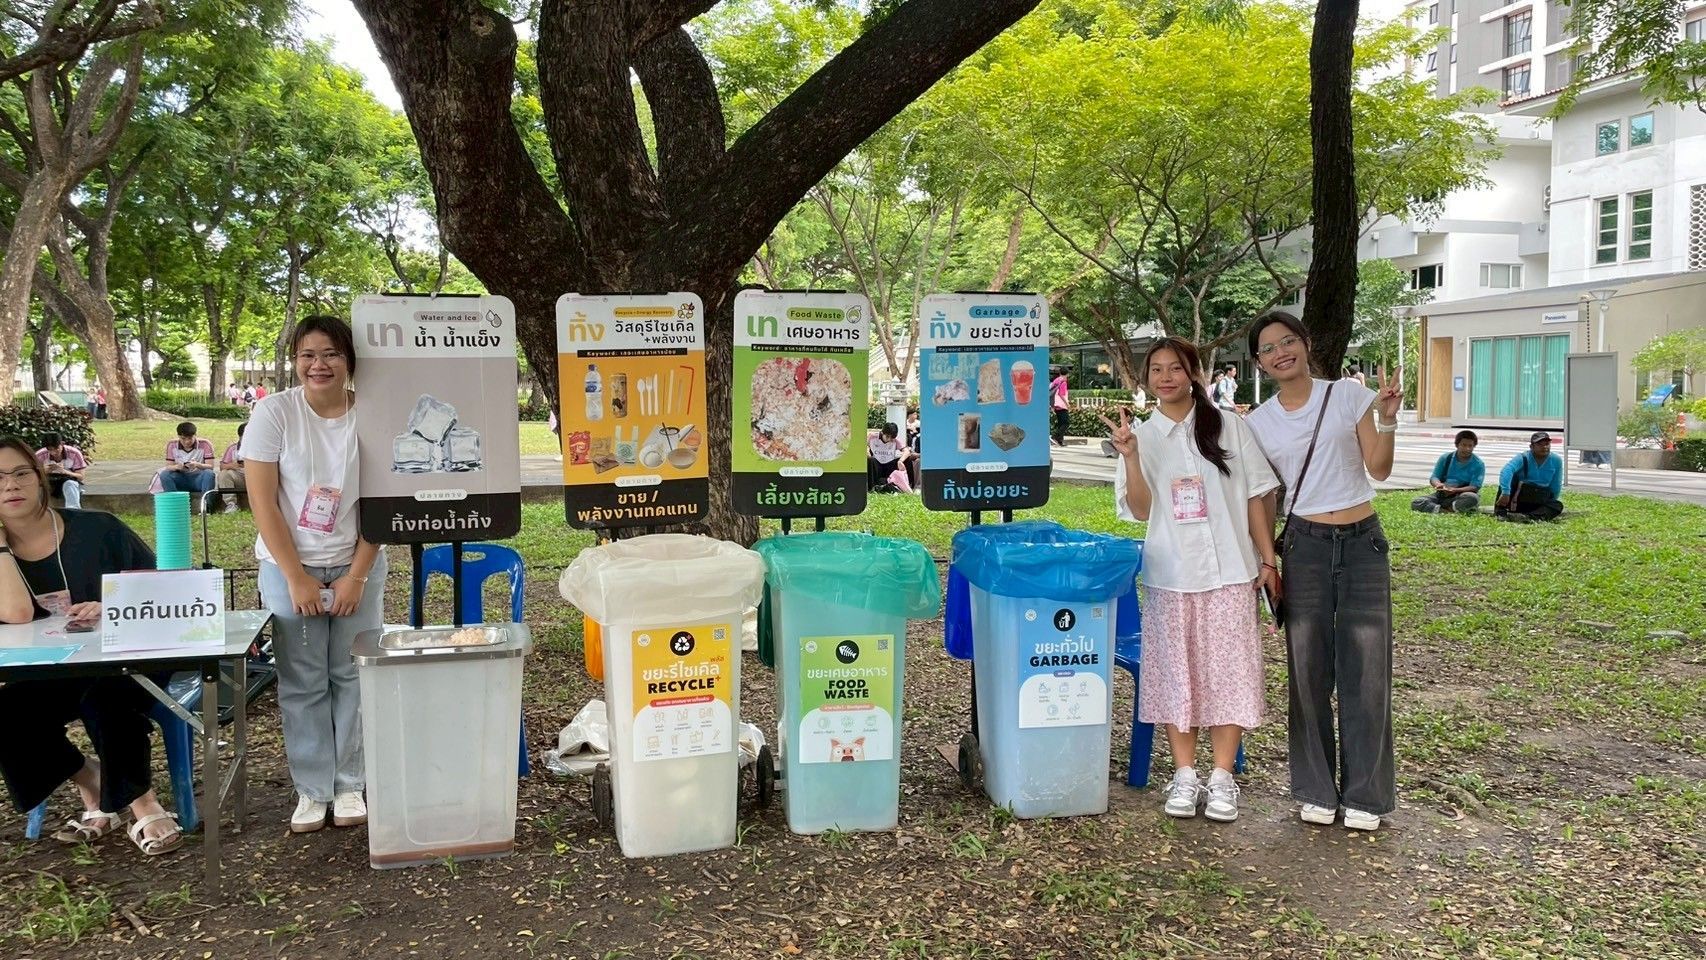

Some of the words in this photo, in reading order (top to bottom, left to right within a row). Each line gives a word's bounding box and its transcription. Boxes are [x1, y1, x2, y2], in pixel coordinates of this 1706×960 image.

[790, 310, 812, 318] Food
[815, 311, 842, 319] Waste
[975, 308, 1020, 317] Garbage
[568, 311, 606, 342] ทิ้ง
[615, 319, 695, 336] วัสดุรีไซเคิล
[746, 315, 778, 337] เท
[787, 327, 860, 340] เศษอาหาร
[929, 310, 961, 339] ทิ้ง
[970, 319, 1042, 339] ขยะทั่วไป
[366, 323, 404, 347] เท
[414, 326, 436, 347] น้ำ
[443, 326, 501, 347] น้ำแข็ง
[618, 492, 647, 504] ขาย
[756, 482, 845, 505] เลี้ยงสัตว์
[943, 479, 1029, 500] ทิ้งบ่อขยะ
[392, 509, 492, 532] ทิ้งท่อน้ำทิ้ง
[577, 503, 698, 521] พลังงานทดแทน
[106, 597, 218, 627] จุดคืนแก้ว
[1034, 634, 1095, 654] ขยะทั่วไป
[1029, 654, 1099, 668] GARBAGE
[807, 666, 888, 679] ขยะเศษอาหาร
[824, 688, 869, 699] WASTE
[828, 679, 867, 690] FOOD
